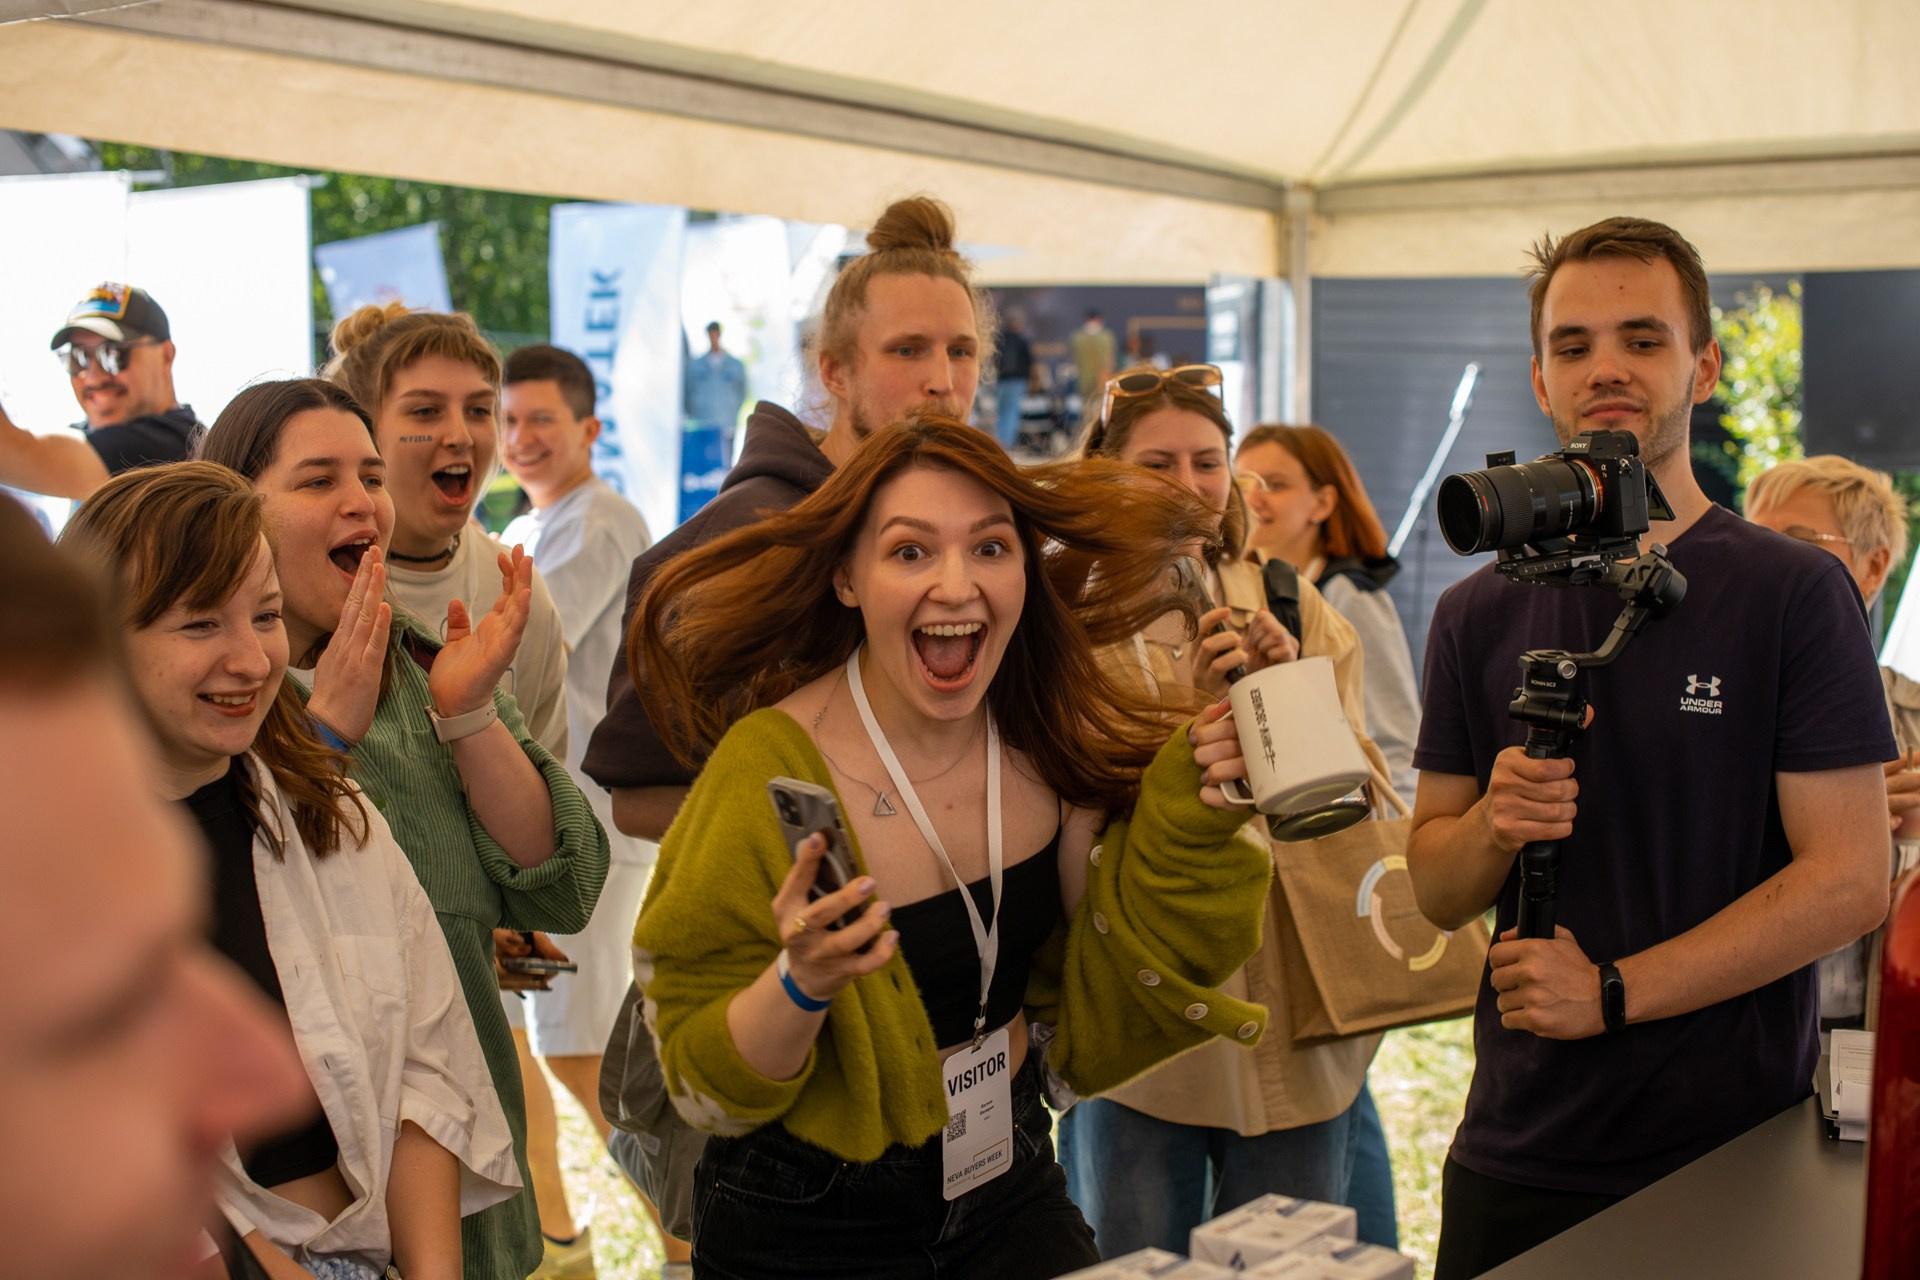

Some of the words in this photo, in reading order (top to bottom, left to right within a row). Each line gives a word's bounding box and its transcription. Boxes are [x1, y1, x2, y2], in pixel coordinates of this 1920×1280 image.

[1679, 705, 1722, 715] ARMOUR
[1680, 696, 1723, 709] UNDER
[947, 1051, 1007, 1097] VISITOR
[946, 1170, 963, 1184] NEVA
[963, 1158, 986, 1176] BUYERS
[986, 1149, 1003, 1164] WEEK
